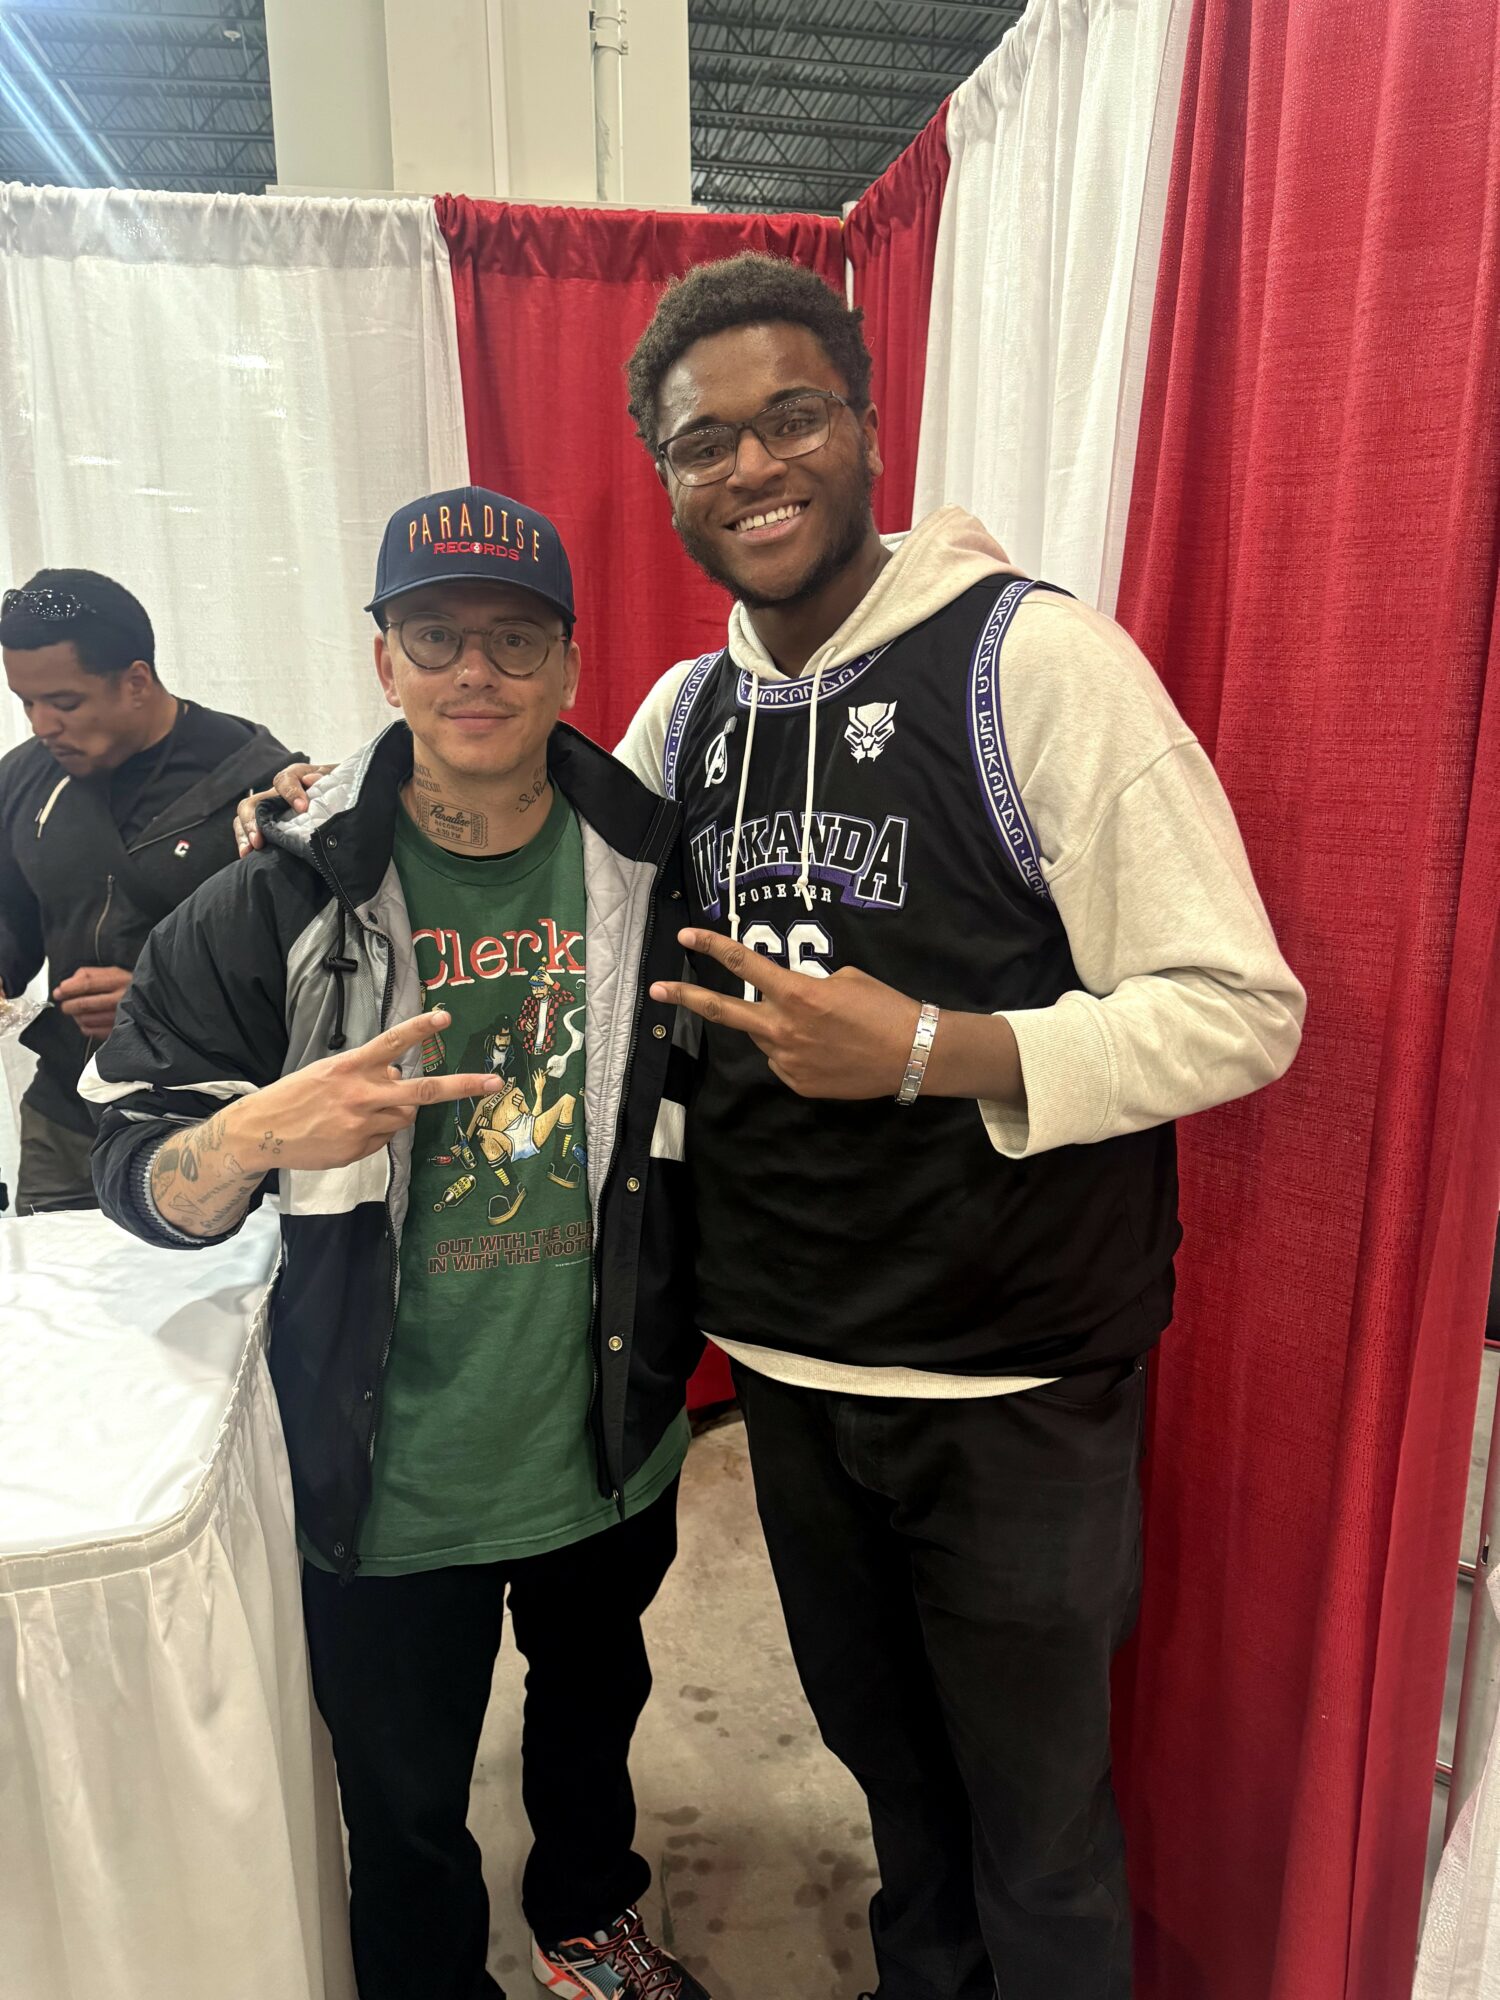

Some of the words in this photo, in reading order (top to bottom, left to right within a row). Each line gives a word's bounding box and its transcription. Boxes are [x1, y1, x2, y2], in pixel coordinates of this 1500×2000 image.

[408, 502, 540, 562] PARADISE
[433, 541, 521, 561] RECORDS
[690, 811, 908, 913] WAKANDA
[412, 918, 586, 990] Clerk
[427, 1257, 448, 1274] IN
[452, 1251, 499, 1272] WITH
[503, 1246, 541, 1266] THE
[436, 1237, 474, 1257] OUT
[479, 1231, 527, 1253] WITH
[530, 1224, 561, 1246] THE
